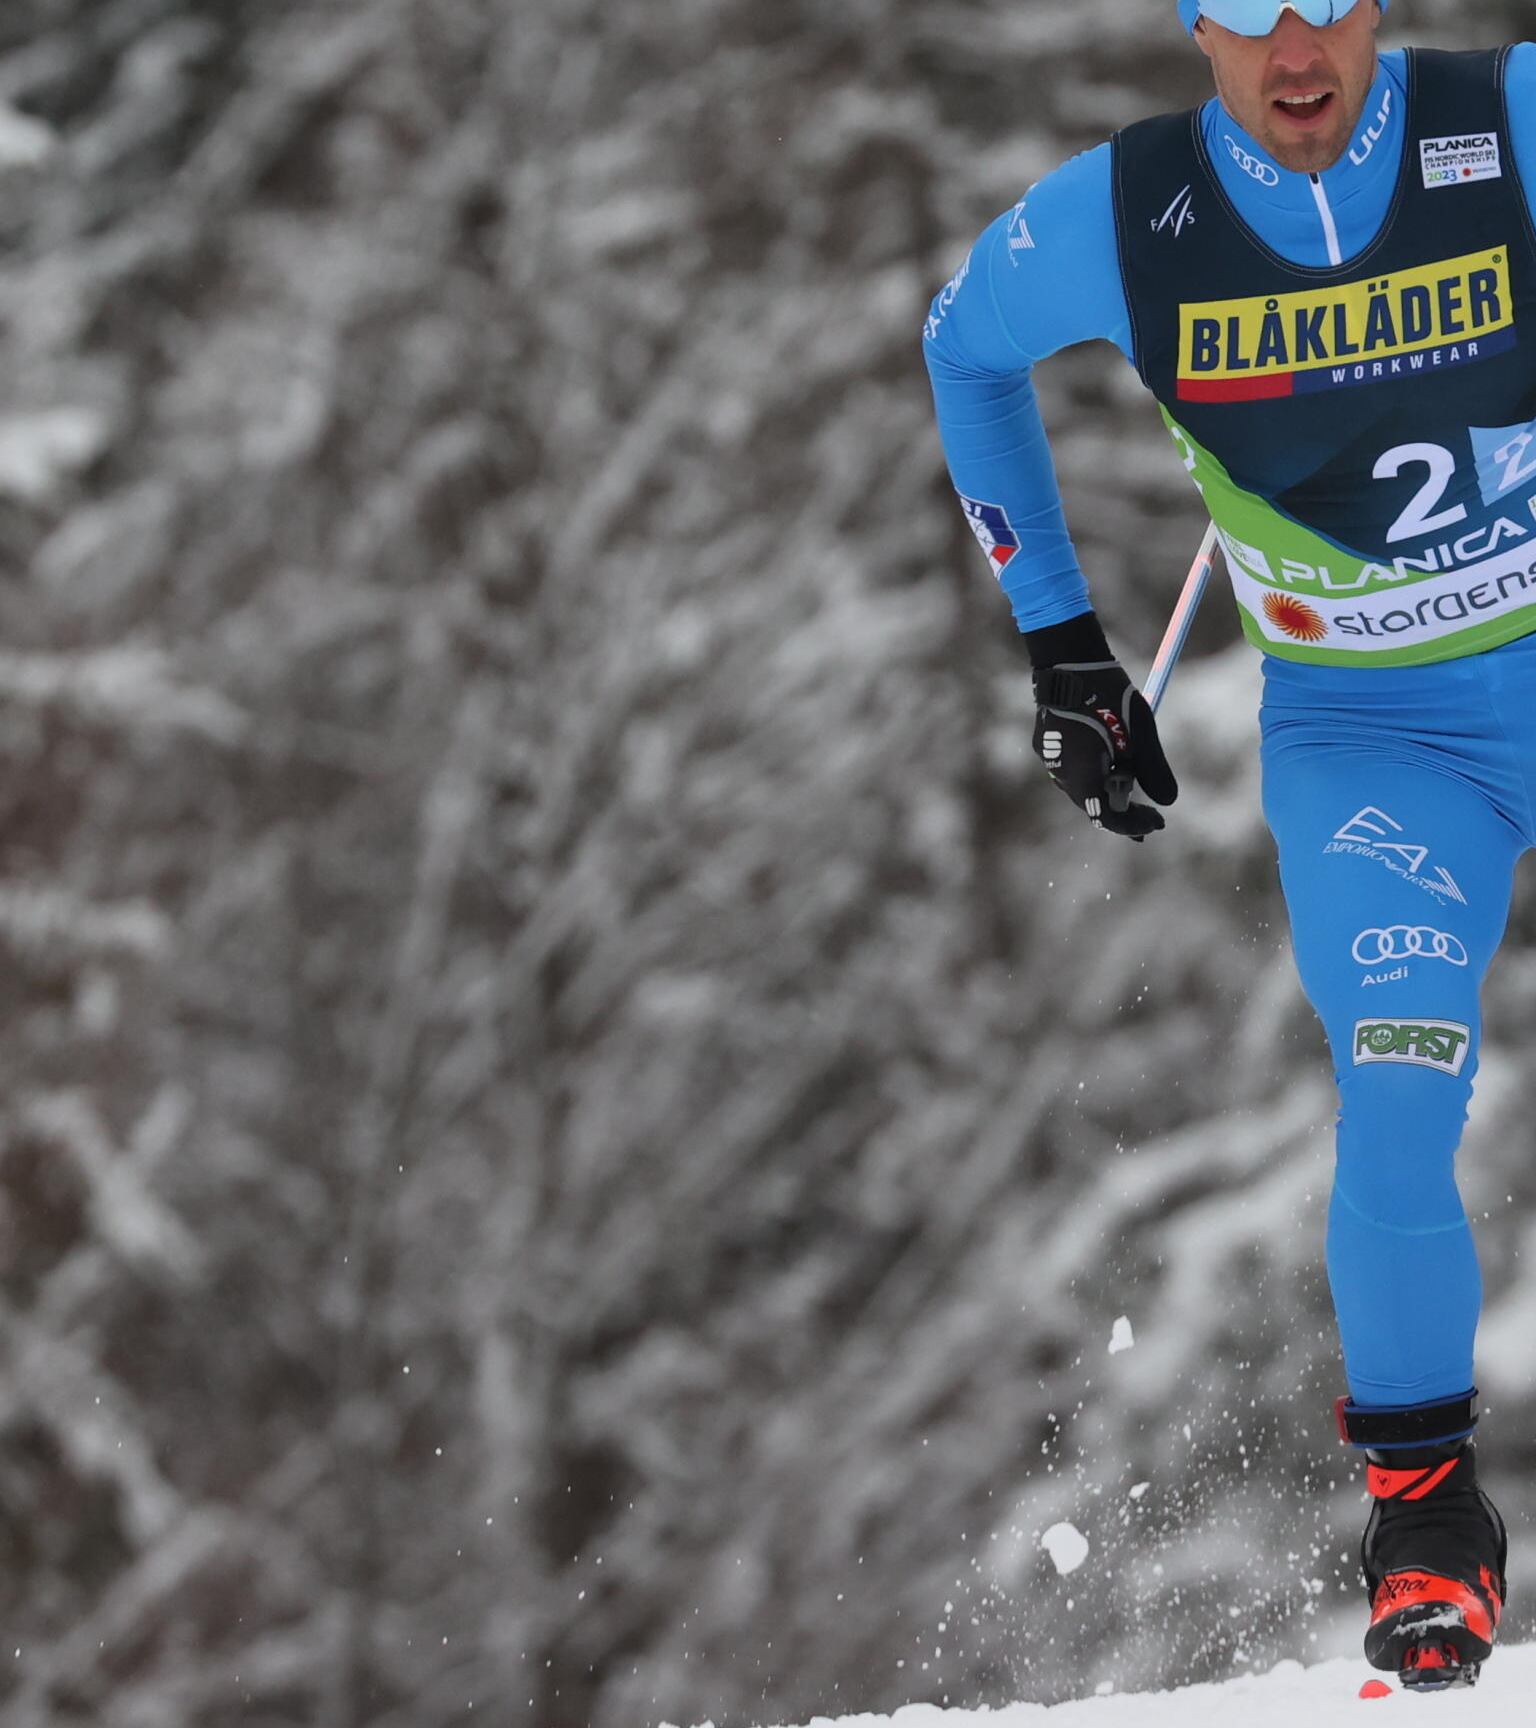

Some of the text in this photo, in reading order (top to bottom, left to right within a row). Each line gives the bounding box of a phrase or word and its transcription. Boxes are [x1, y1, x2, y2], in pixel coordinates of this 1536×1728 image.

[1423, 136, 1494, 155] PLANICA
[1435, 153, 1460, 163] NORDIC
[1460, 150, 1484, 160] WORLD
[1424, 155, 1496, 171] CHAMPIONSHIPS
[1426, 168, 1458, 183] 2023
[1191, 266, 1503, 372] BLÅKLÄDER
[1331, 342, 1479, 384] WORKWEAR
[1372, 442, 1468, 544] 2
[1280, 516, 1529, 591] PLANICA
[1361, 965, 1409, 988] Audi
[1356, 1023, 1467, 1064] FORST
